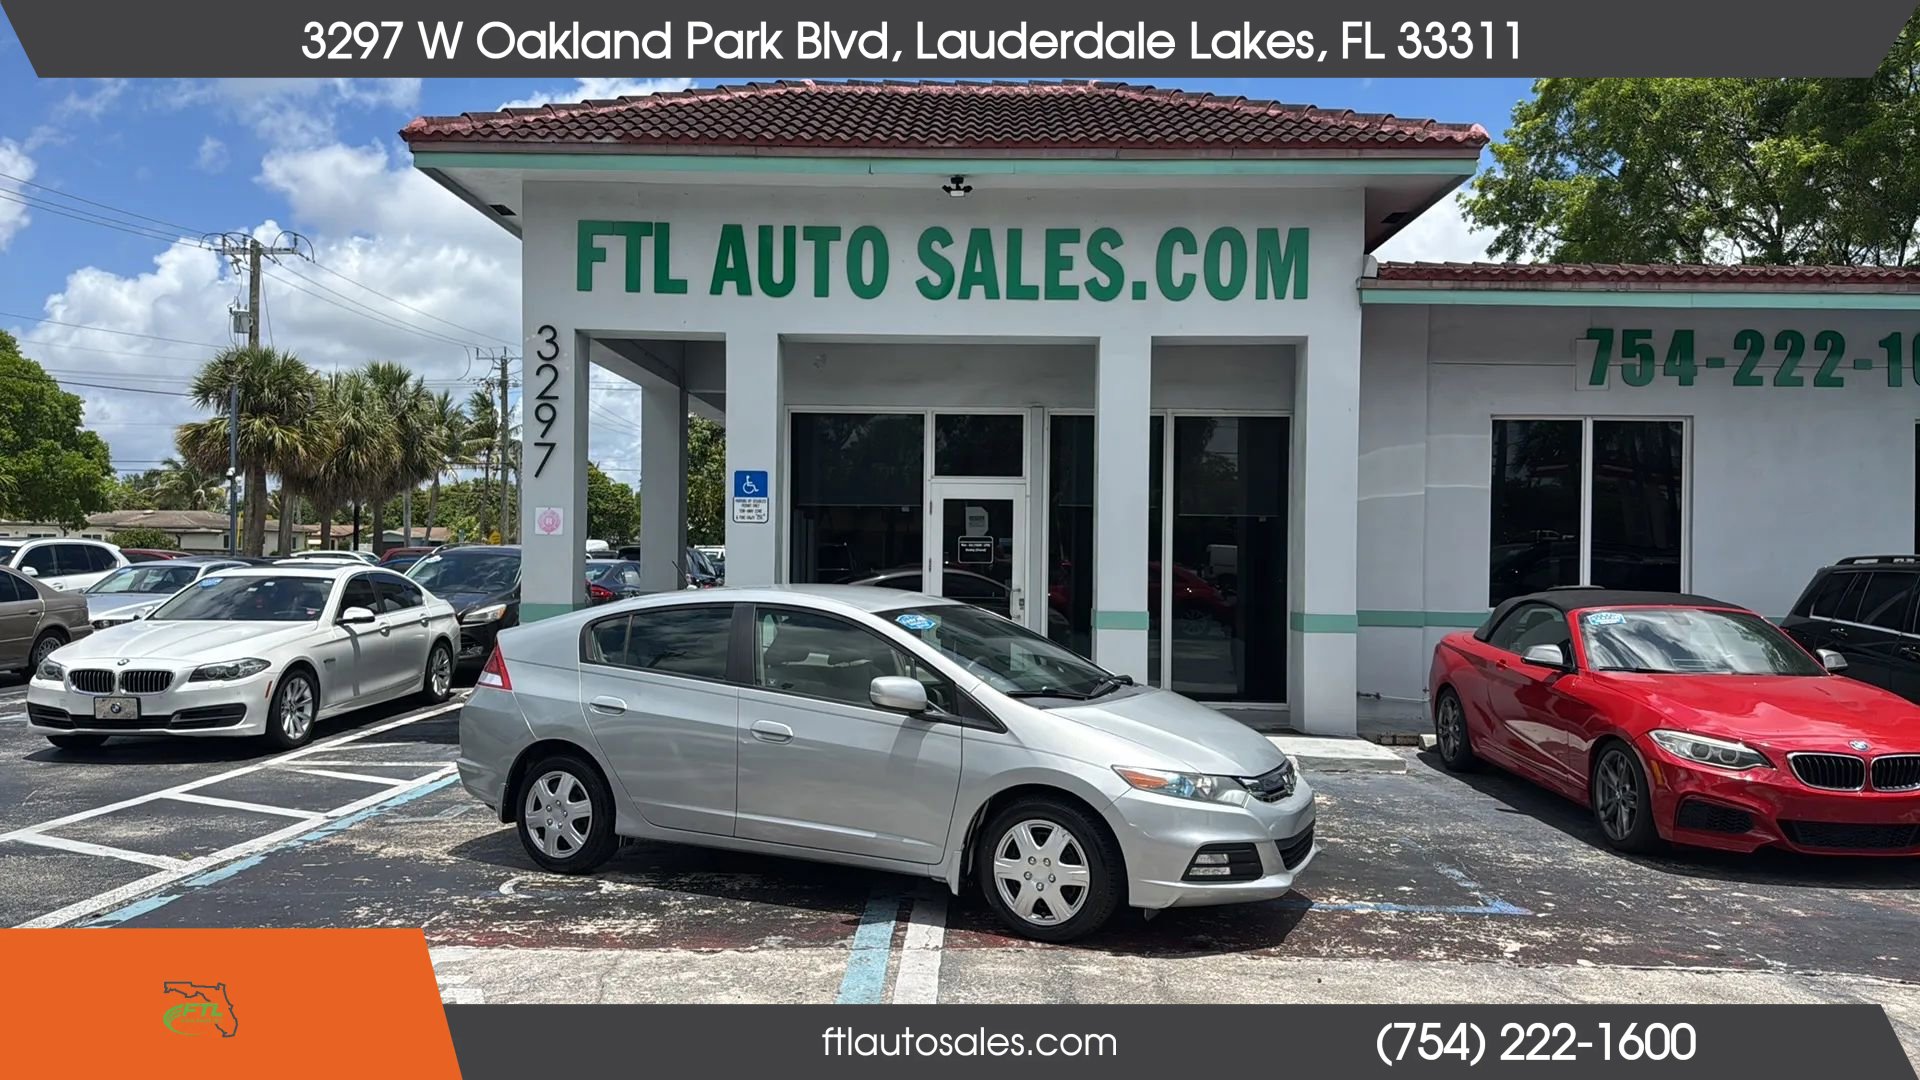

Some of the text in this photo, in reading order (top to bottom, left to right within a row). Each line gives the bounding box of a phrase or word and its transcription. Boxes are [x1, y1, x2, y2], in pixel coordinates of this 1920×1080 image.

[576, 220, 1310, 302] FTL AUTO SALES.COM
[1586, 328, 1920, 387] 754-222-1
[533, 324, 560, 479] 3297
